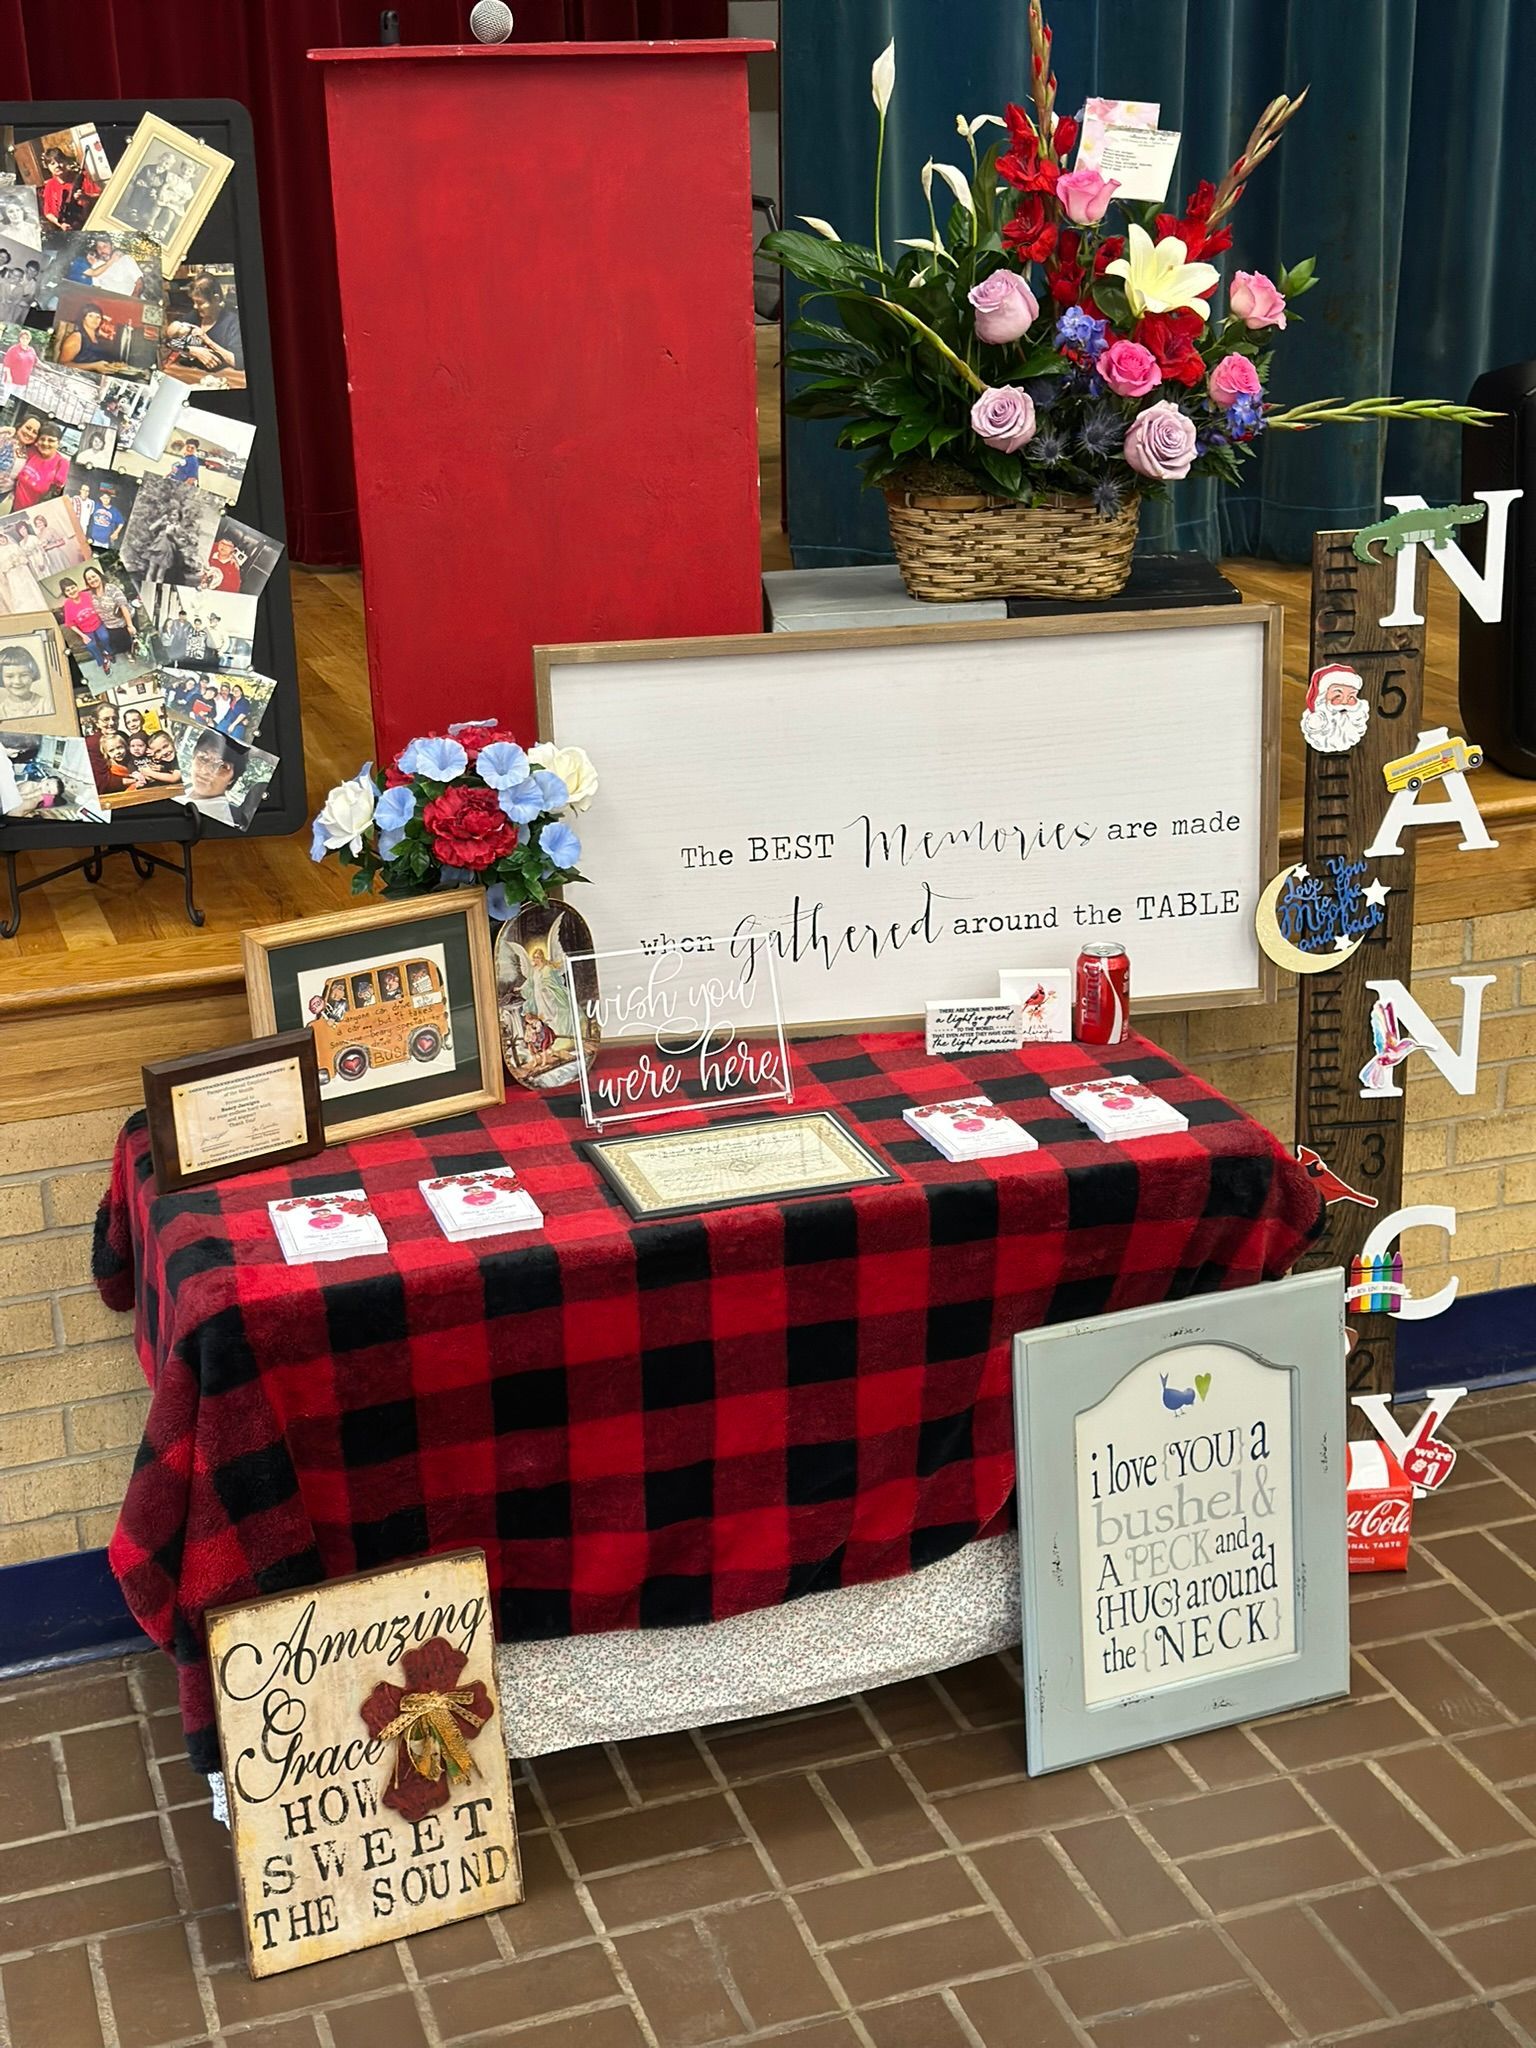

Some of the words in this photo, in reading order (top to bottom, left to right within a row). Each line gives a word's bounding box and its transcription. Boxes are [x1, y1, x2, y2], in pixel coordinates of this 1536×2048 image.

[1376, 669, 1408, 720] 5
[681, 845, 734, 869] The
[748, 833, 835, 864] BEST
[842, 814, 1099, 869] Memories
[1106, 820, 1158, 841] are
[1171, 811, 1242, 837] made
[952, 906, 1059, 937] around
[1072, 902, 1123, 926] the
[1136, 889, 1241, 921] TABLE
[586, 951, 677, 1028] wish
[946, 1011, 976, 1029] light
[987, 1010, 1014, 1026] great
[599, 1054, 682, 1108] were
[699, 1020, 780, 1092] here
[951, 1036, 979, 1051] light
[1360, 1132, 1387, 1180] 3
[1346, 1349, 1375, 1392] 2
[1091, 1452, 1101, 1500] i
[1108, 1443, 1158, 1495] love
[1250, 1420, 1271, 1461] a
[1409, 1458, 1441, 1485] #1
[1414, 1447, 1453, 1462] we're
[1091, 1469, 1245, 1548] bushel
[1252, 1464, 1276, 1518] &
[1347, 1499, 1410, 1538] a-Cola
[1096, 1553, 1124, 1592] A
[1125, 1528, 1214, 1583] PECK
[1215, 1516, 1250, 1556] and
[1251, 1530, 1266, 1560] a
[1186, 1543, 1279, 1610] around
[219, 1590, 488, 1700] Amazing
[1102, 1636, 1137, 1675] the
[234, 1687, 386, 1804] Grace
[279, 1778, 381, 1841] HOW
[262, 1797, 493, 1898] SWEET
[253, 1895, 339, 1951] THE
[373, 1844, 510, 1918] SOUND
